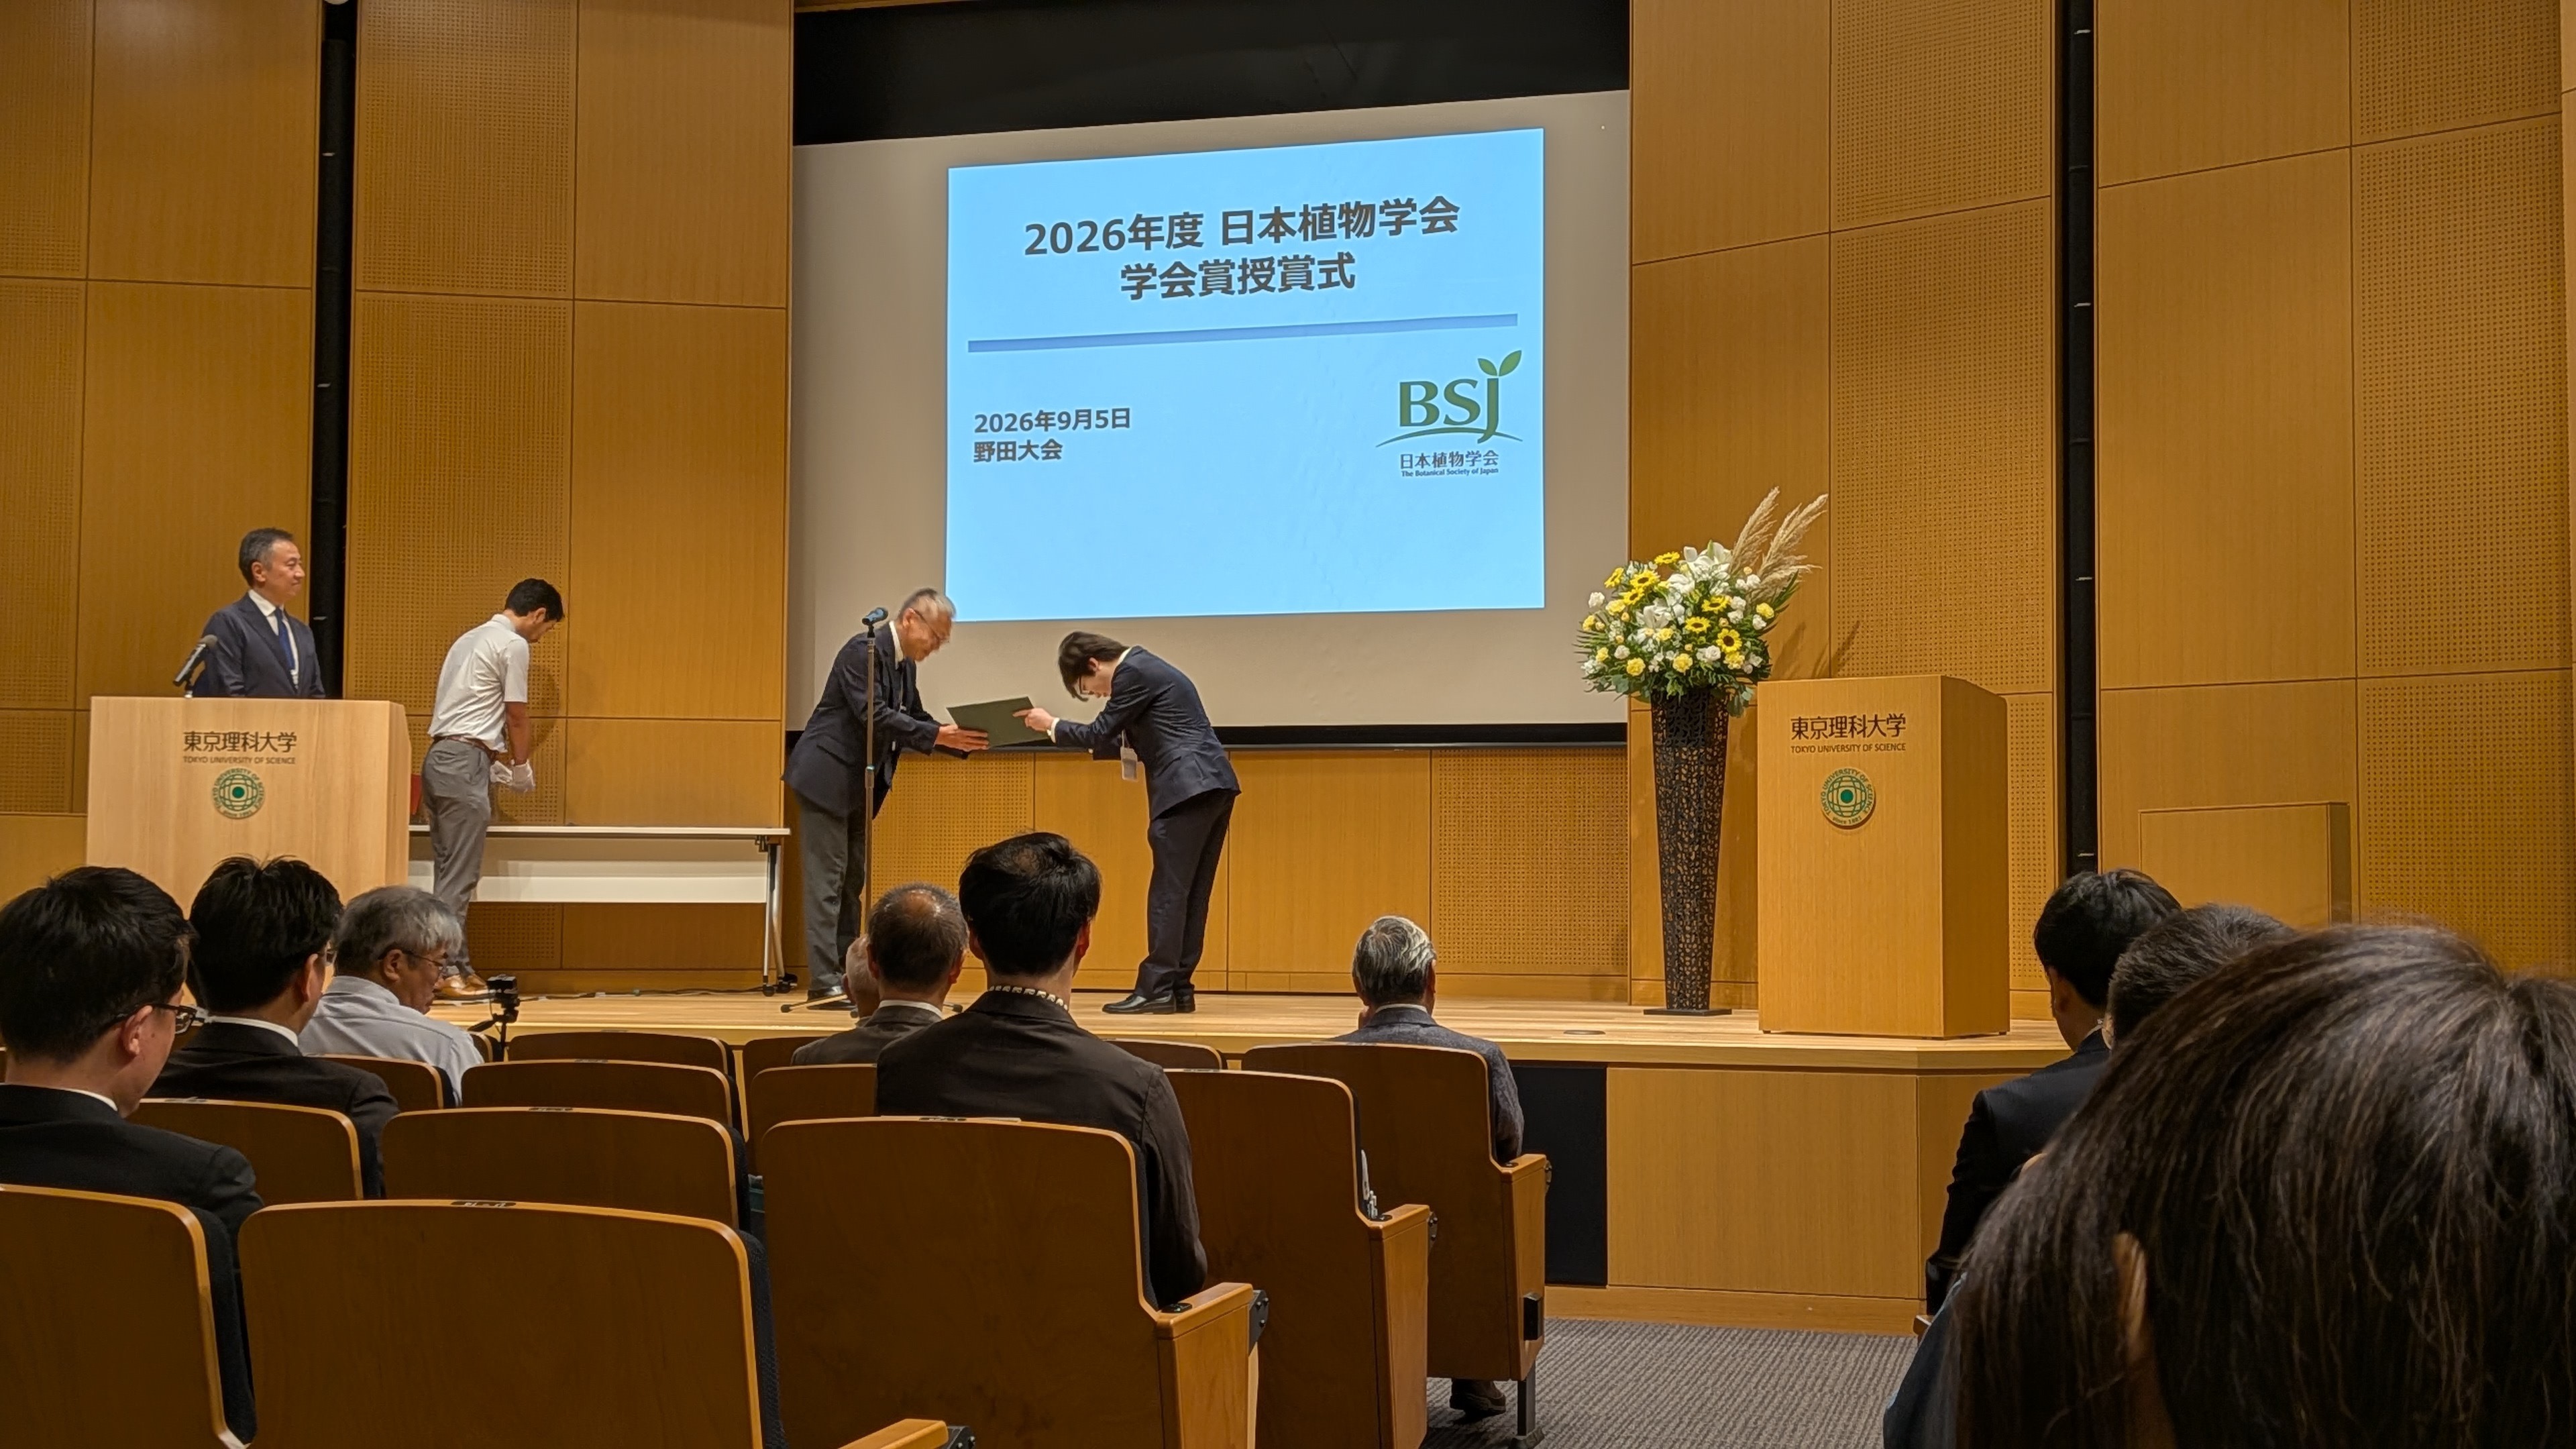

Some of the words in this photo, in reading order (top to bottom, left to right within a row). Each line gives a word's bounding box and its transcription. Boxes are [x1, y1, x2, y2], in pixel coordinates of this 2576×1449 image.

[1024, 212, 1204, 256] 2026年度
[1222, 195, 1460, 247] 日本植物学会
[1120, 252, 1356, 301] 学会賞授賞式
[974, 408, 1132, 433] 2026年9月5日
[1399, 378, 1499, 444] BSJ
[973, 439, 1063, 464] 野田大会
[1400, 450, 1499, 469] 日本植物学会
[1790, 713, 1907, 740] 東京理科大学
[183, 731, 297, 753] 東京理科大学
[1790, 745, 1816, 753] TOKYO
[1817, 744, 1862, 753] UNIVERSITY
[1862, 743, 1873, 751] OF
[1874, 743, 1907, 751] SCIENCE
[183, 755, 208, 763] TOKYO
[210, 756, 252, 764] UNIVERSITY
[1822, 768, 1860, 790] UNIVERSITY
[1860, 774, 1869, 782] OF
[1821, 791, 1831, 816] TOKYO
